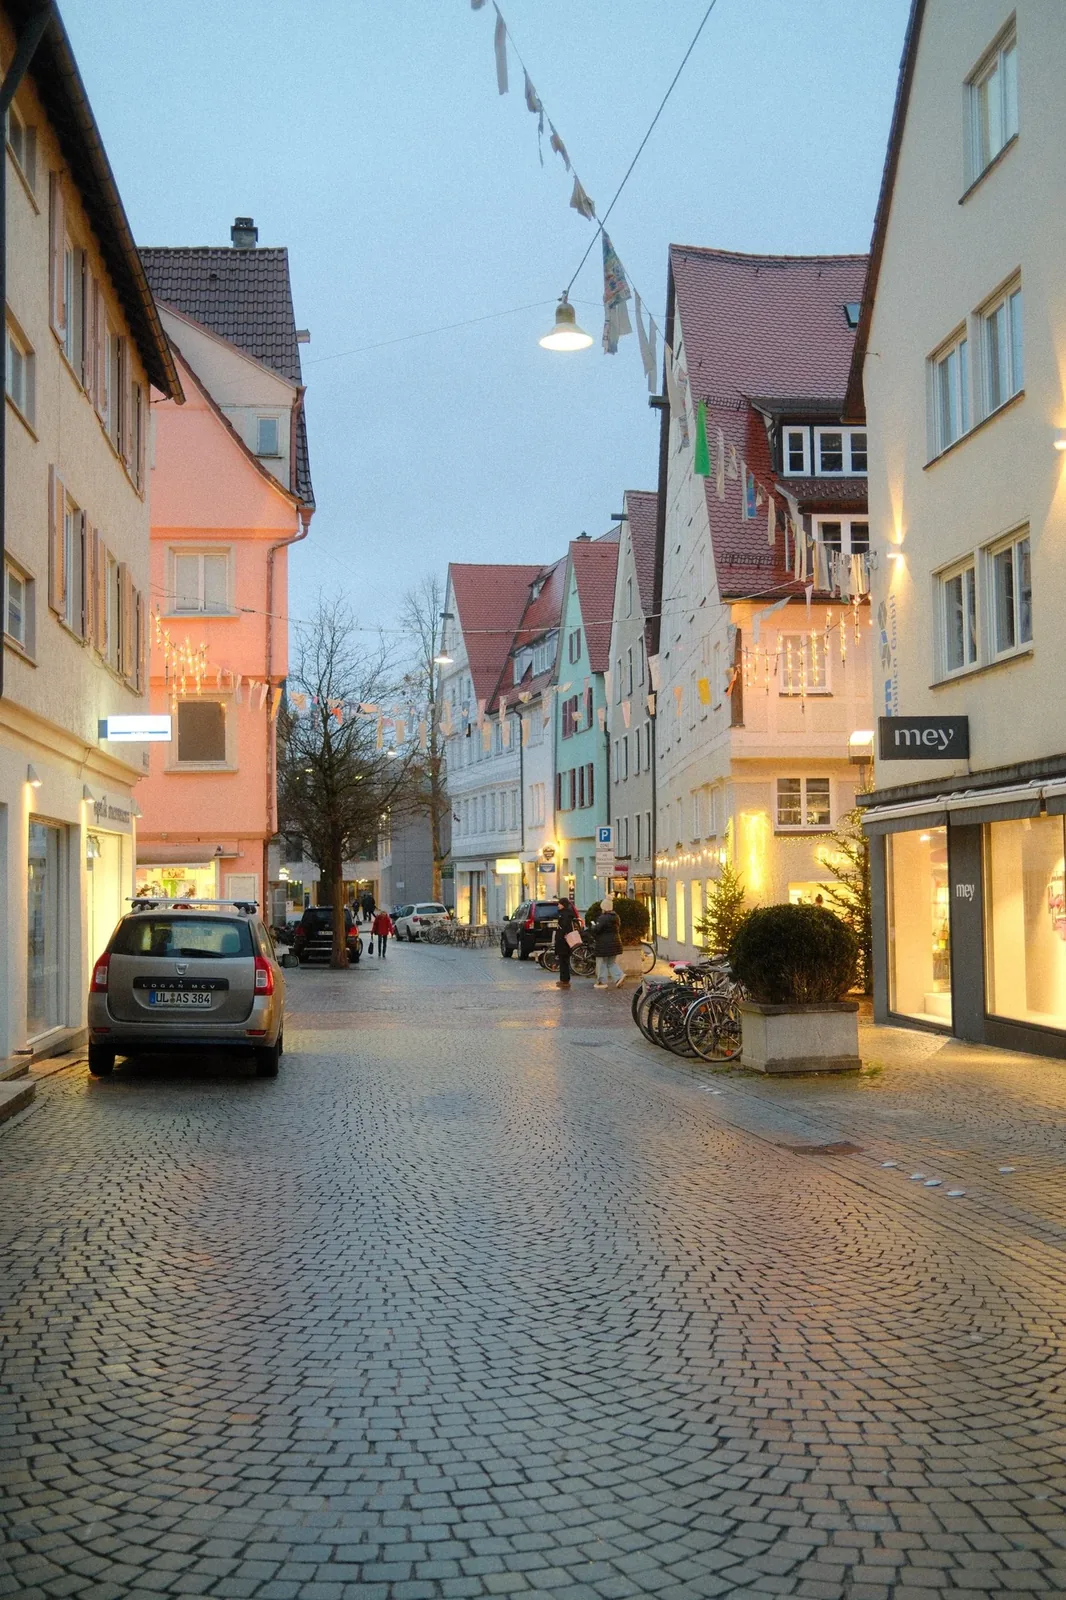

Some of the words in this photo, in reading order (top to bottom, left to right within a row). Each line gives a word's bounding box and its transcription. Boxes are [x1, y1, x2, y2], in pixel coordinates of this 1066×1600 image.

[889, 594, 897, 650] GmbH
[894, 728, 954, 751] mey
[956, 884, 975, 902] mey
[156, 992, 169, 1004] UL
[175, 992, 190, 1004] AS
[191, 992, 211, 1004] 384
